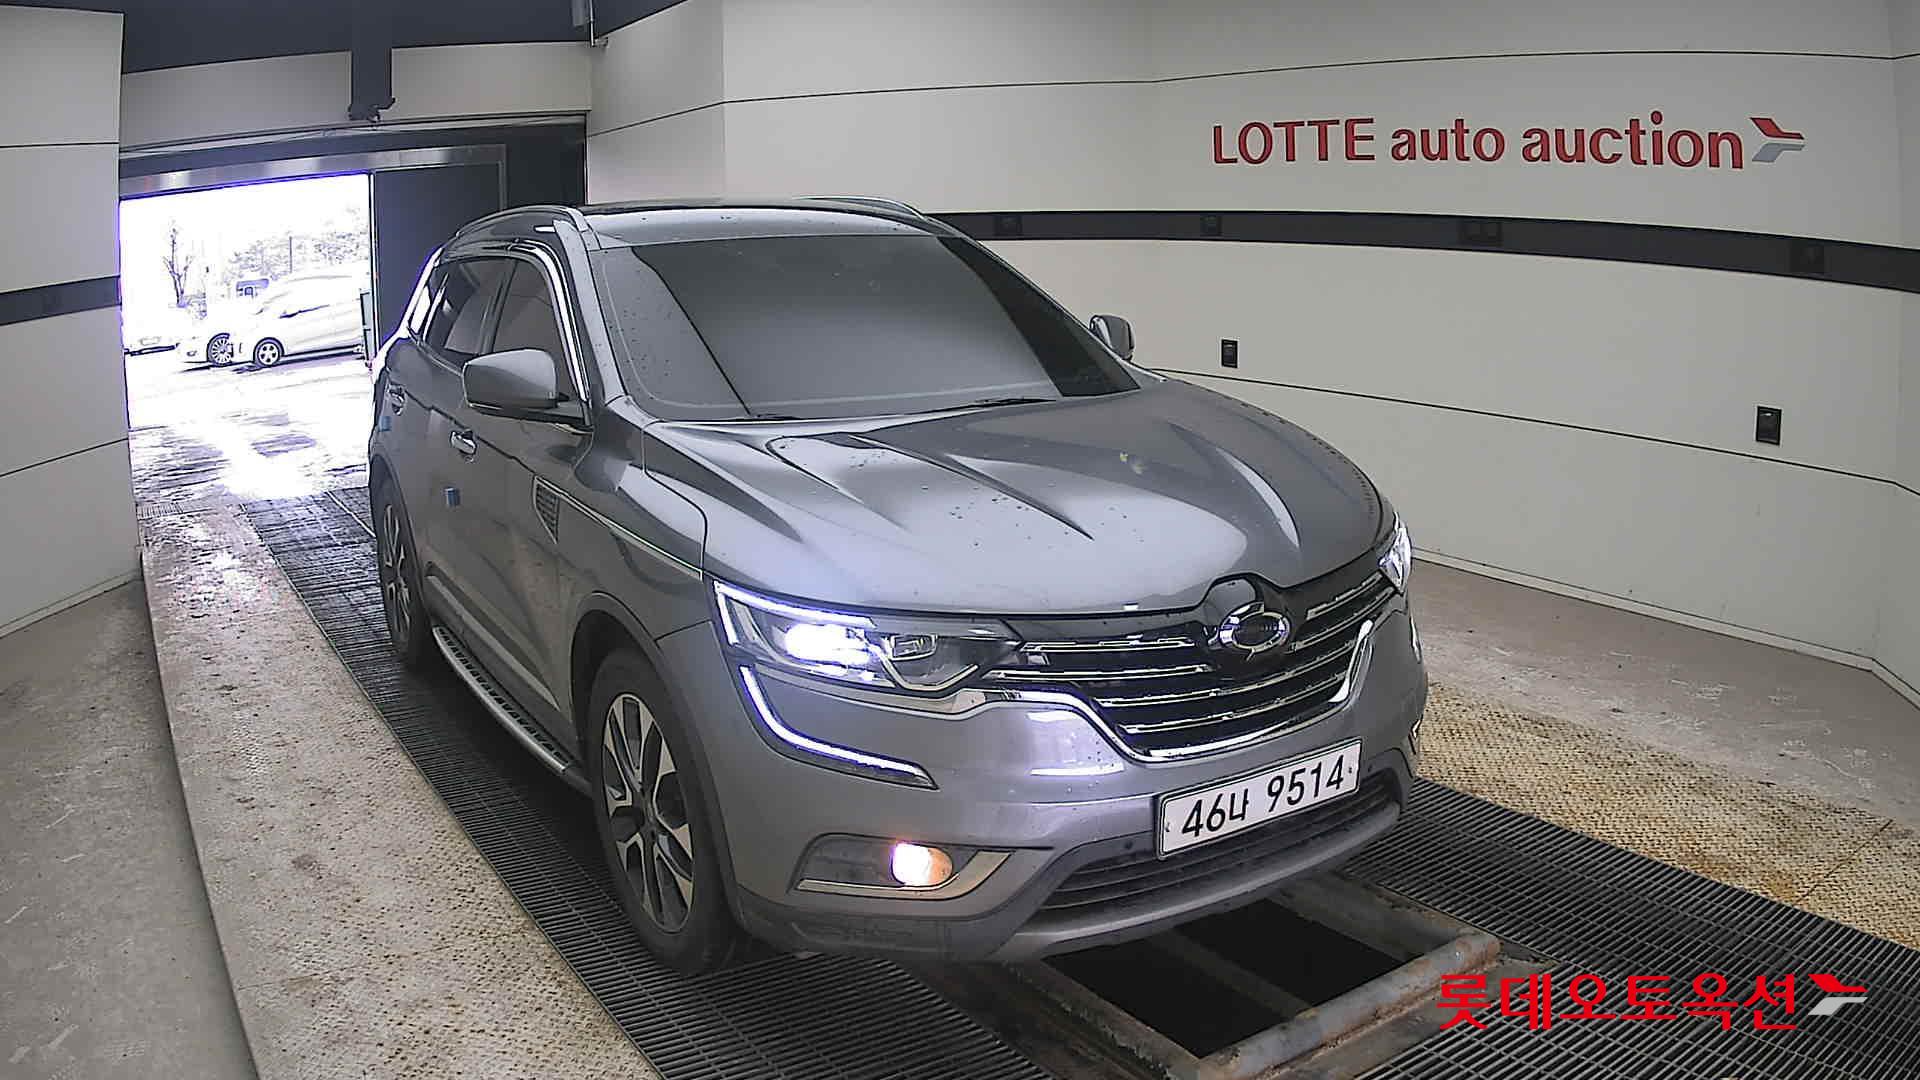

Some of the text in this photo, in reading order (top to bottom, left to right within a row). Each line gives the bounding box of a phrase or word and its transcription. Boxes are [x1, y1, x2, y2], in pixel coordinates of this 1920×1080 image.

[1212, 110, 1745, 169] LOTTE auto auction
[1181, 754, 1345, 838] 46나 9514
